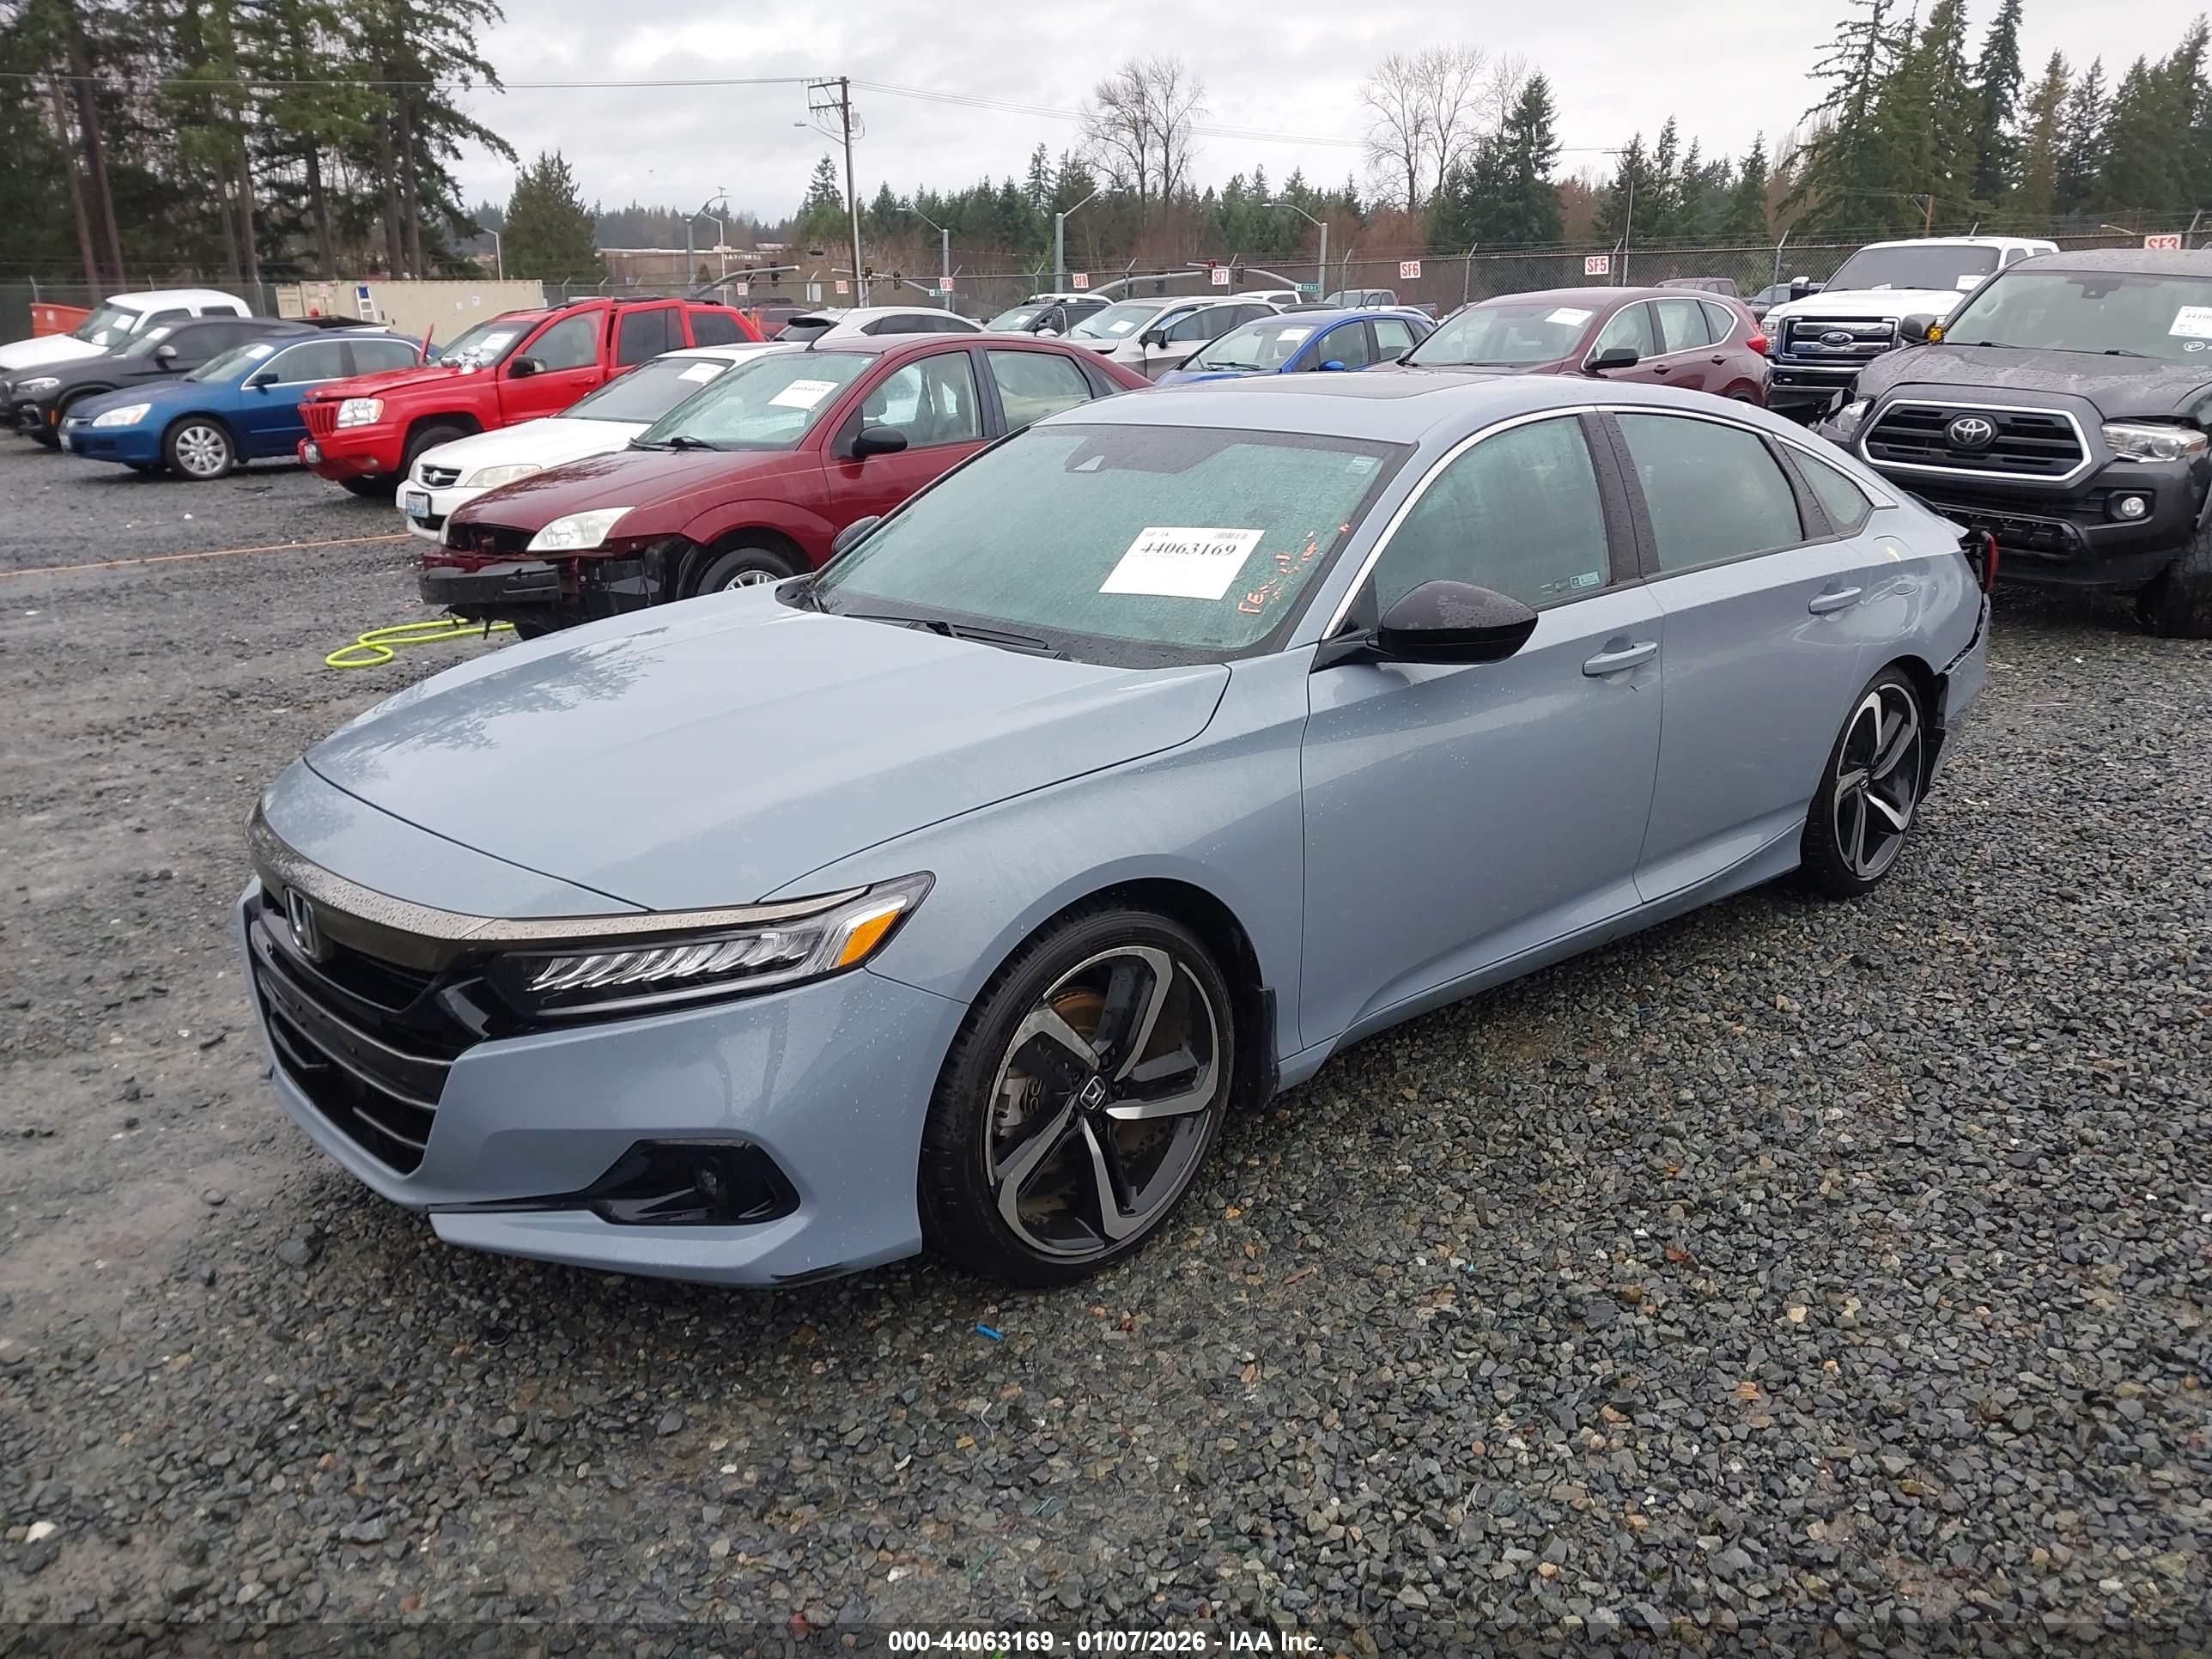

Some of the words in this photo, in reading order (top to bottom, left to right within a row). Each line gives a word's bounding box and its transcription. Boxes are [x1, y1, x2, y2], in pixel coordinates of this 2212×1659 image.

[1401, 263, 1419, 277] SF6
[1588, 258, 1607, 272] SF5
[940, 276, 953, 290] SF9
[1074, 274, 1087, 287] SF8
[1213, 270, 1227, 283] SF7
[1140, 542, 1237, 556] 44063169
